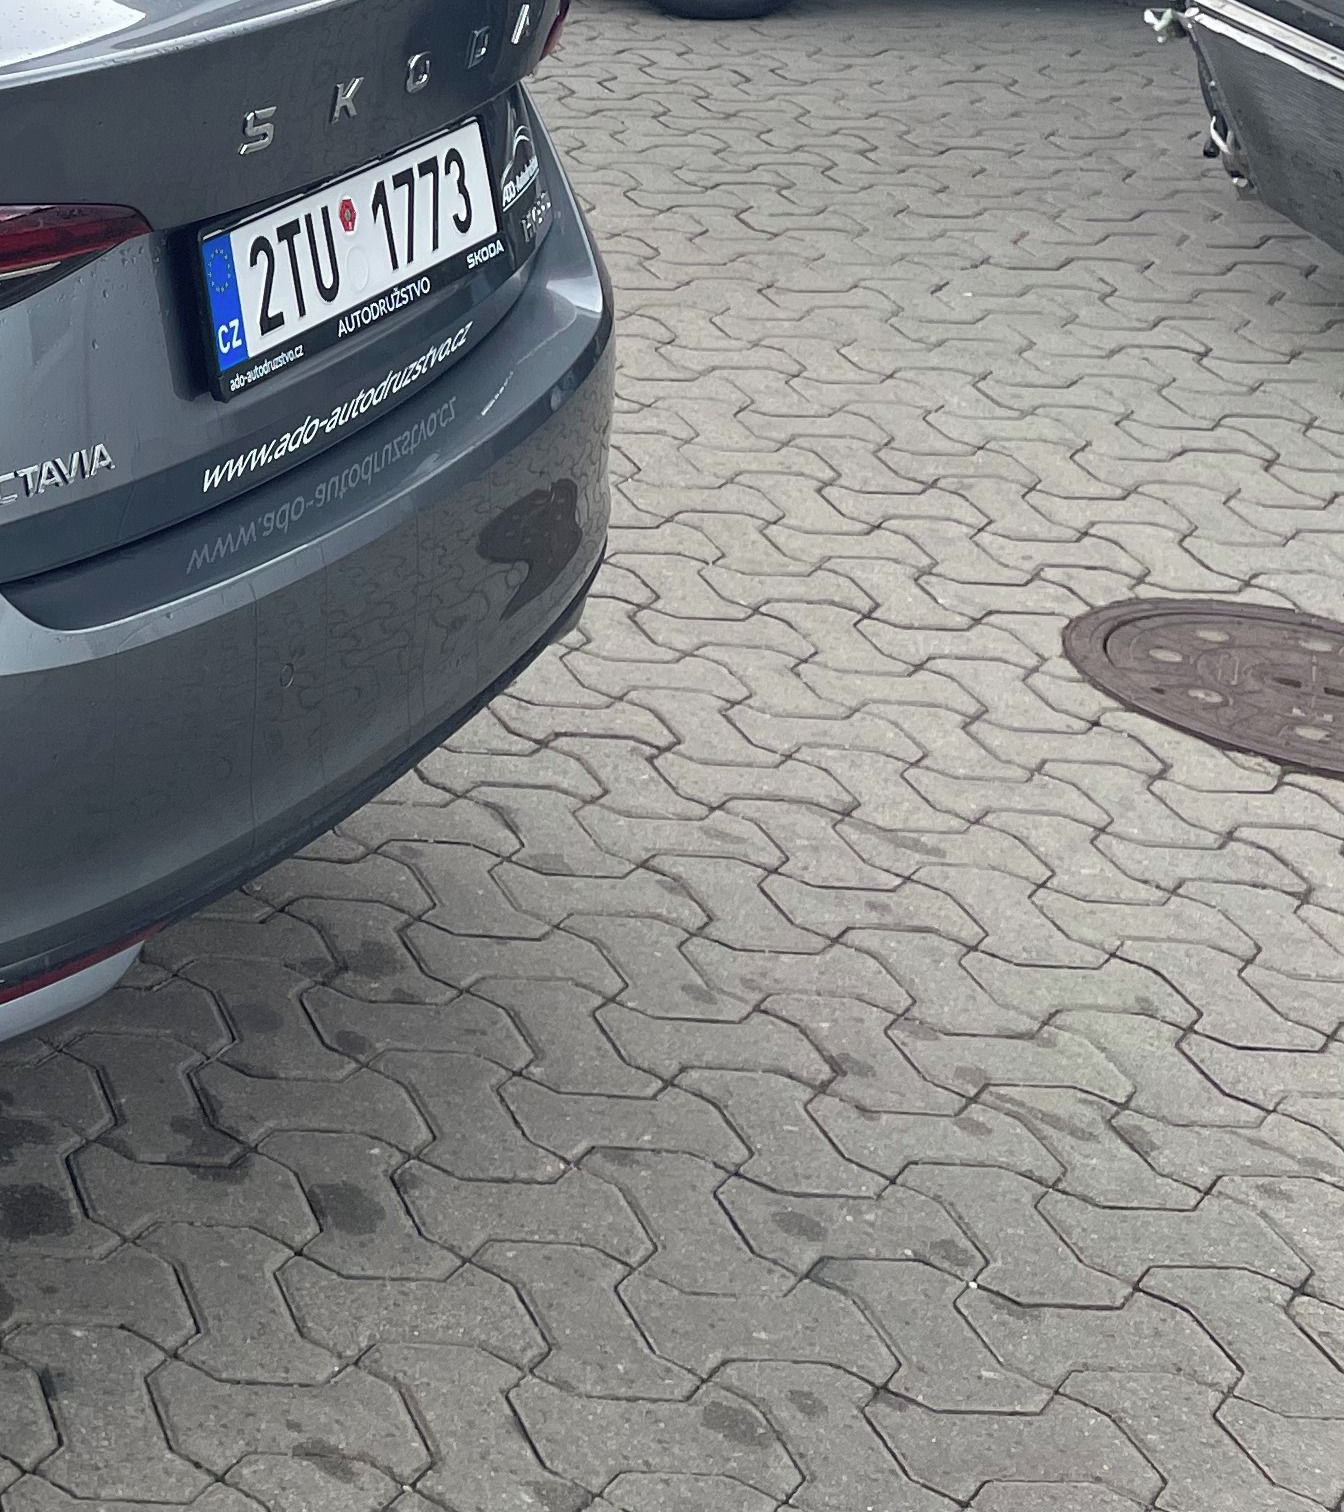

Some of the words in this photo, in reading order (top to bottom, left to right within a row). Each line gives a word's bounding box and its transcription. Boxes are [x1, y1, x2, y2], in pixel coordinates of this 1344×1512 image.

[249, 205, 341, 337] 2TU
[371, 147, 473, 272] 1773
[217, 318, 243, 354] CZ
[337, 276, 432, 338] AUTODRUŽSTVO
[229, 344, 305, 392] ado-autodruzstvo.cz
[202, 320, 474, 493] www.ado-autodruzstvo.cz
